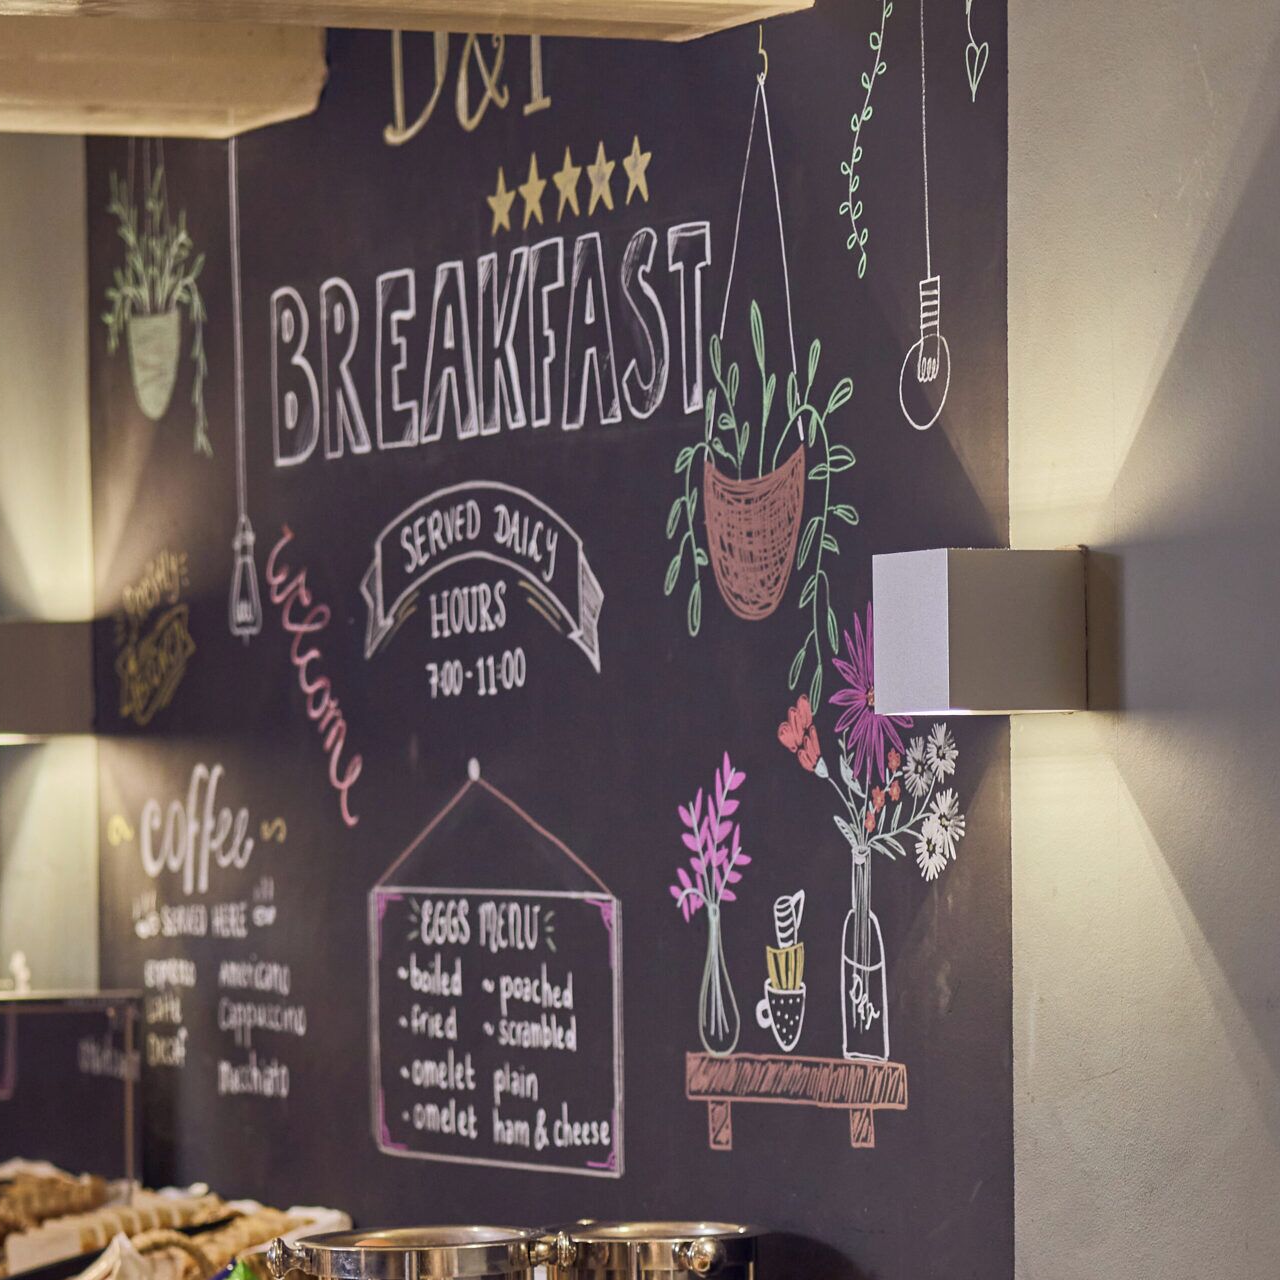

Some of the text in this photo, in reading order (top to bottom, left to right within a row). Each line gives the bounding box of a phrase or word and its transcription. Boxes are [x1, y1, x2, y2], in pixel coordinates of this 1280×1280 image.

[270, 221, 711, 466] BREAKFAST
[400, 500, 558, 582] SERVED DAILY
[429, 580, 507, 639] HOURS
[211, 901, 248, 938] HERE
[421, 899, 541, 953] EGGS MENU
[410, 952, 462, 997] boiled
[500, 962, 573, 1017] poached
[410, 1003, 457, 1040] fried
[499, 1012, 577, 1052] scrambled
[411, 1047, 538, 1106] omelet plain
[412, 1098, 611, 1151] omelet ham & cheese
